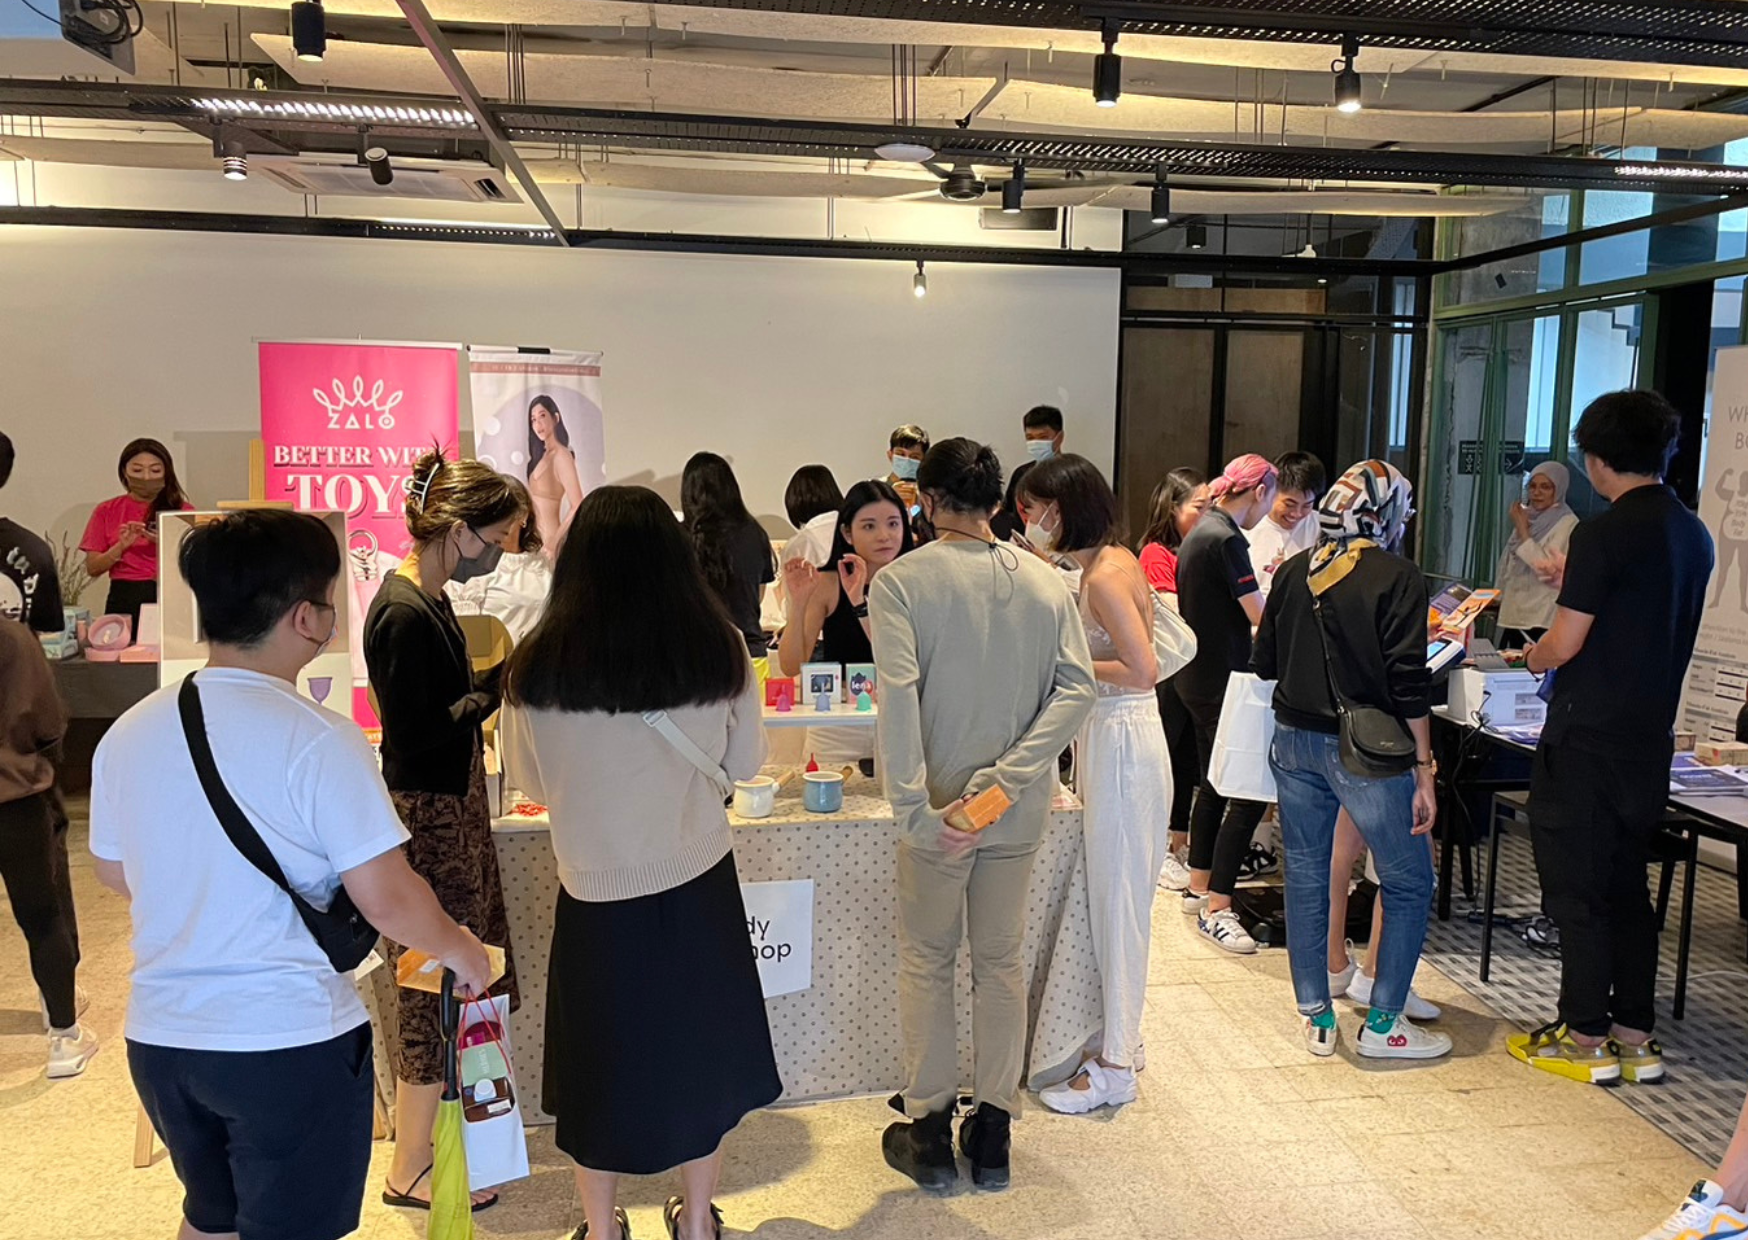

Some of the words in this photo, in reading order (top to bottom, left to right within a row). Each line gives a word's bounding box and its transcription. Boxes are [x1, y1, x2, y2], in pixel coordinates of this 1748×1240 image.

[327, 412, 396, 430] ZALO
[274, 446, 374, 466] BETTER
[377, 446, 436, 466] WIT
